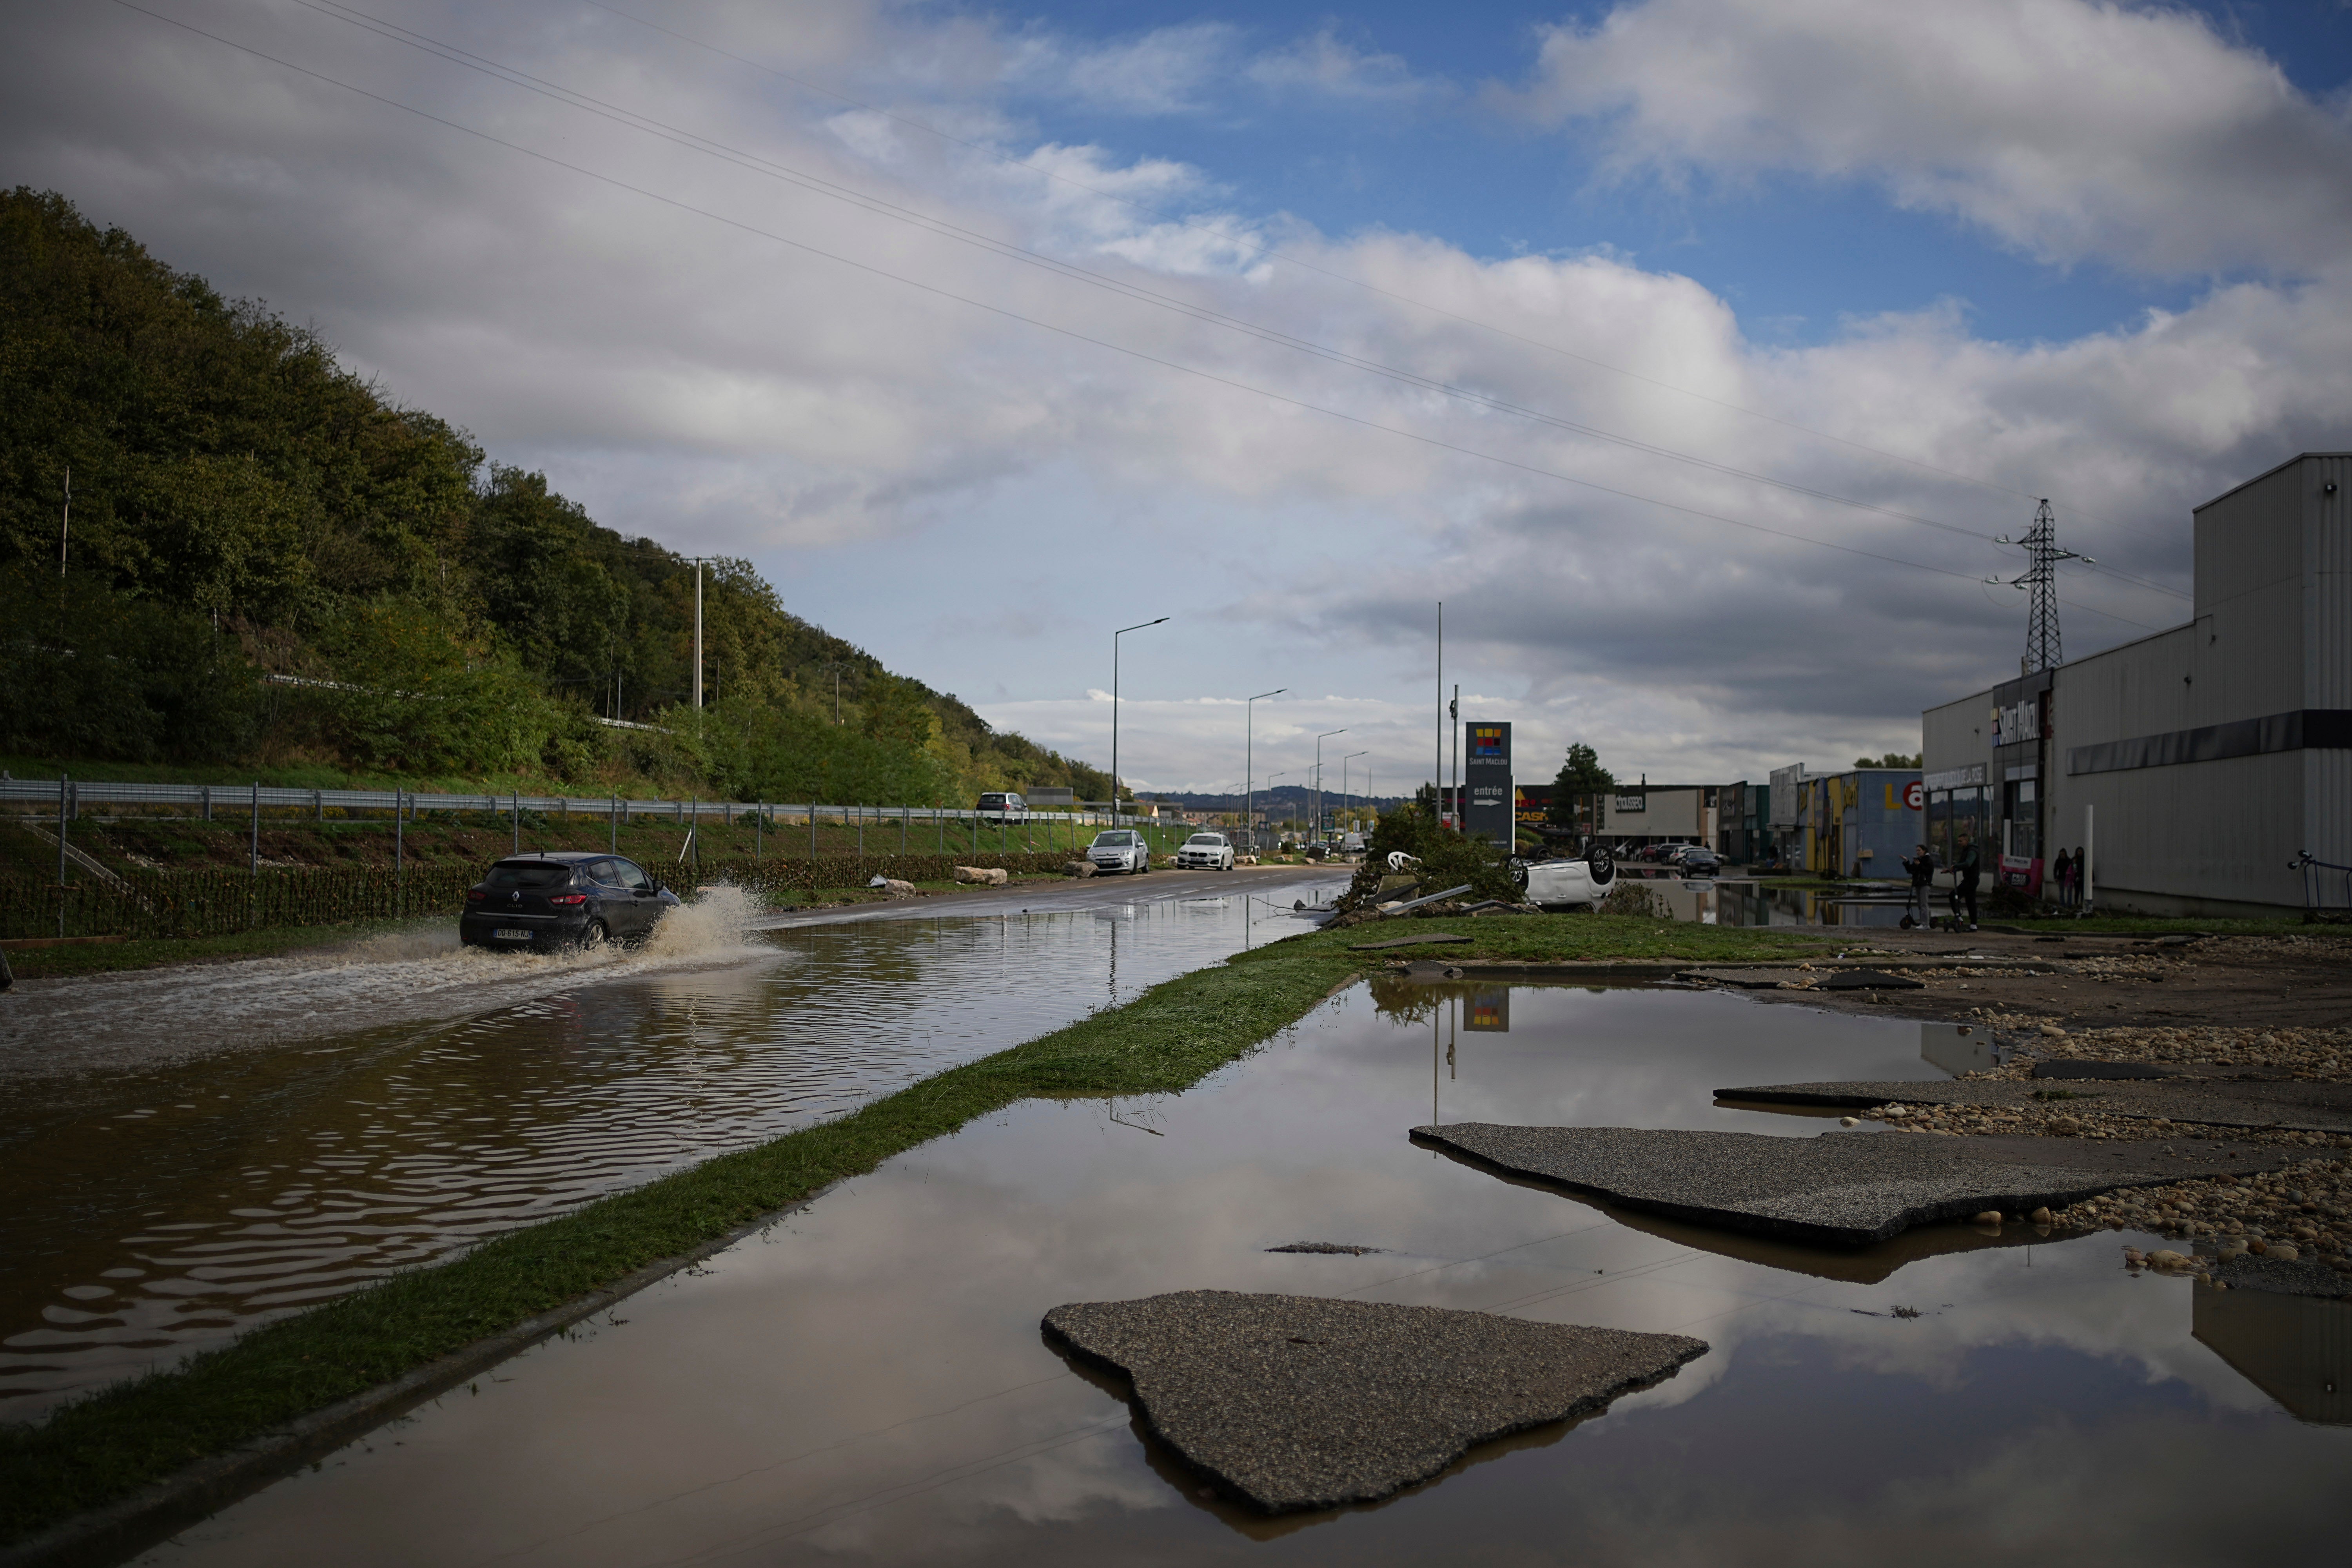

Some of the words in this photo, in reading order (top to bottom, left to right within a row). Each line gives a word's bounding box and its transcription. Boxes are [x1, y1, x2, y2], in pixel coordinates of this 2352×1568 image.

[1469, 757, 1485, 765] SAINT
[1486, 757, 1508, 766] MACLOU
[1474, 785, 1503, 796] entrée
[497, 929, 529, 938] DQ-615-NJ
